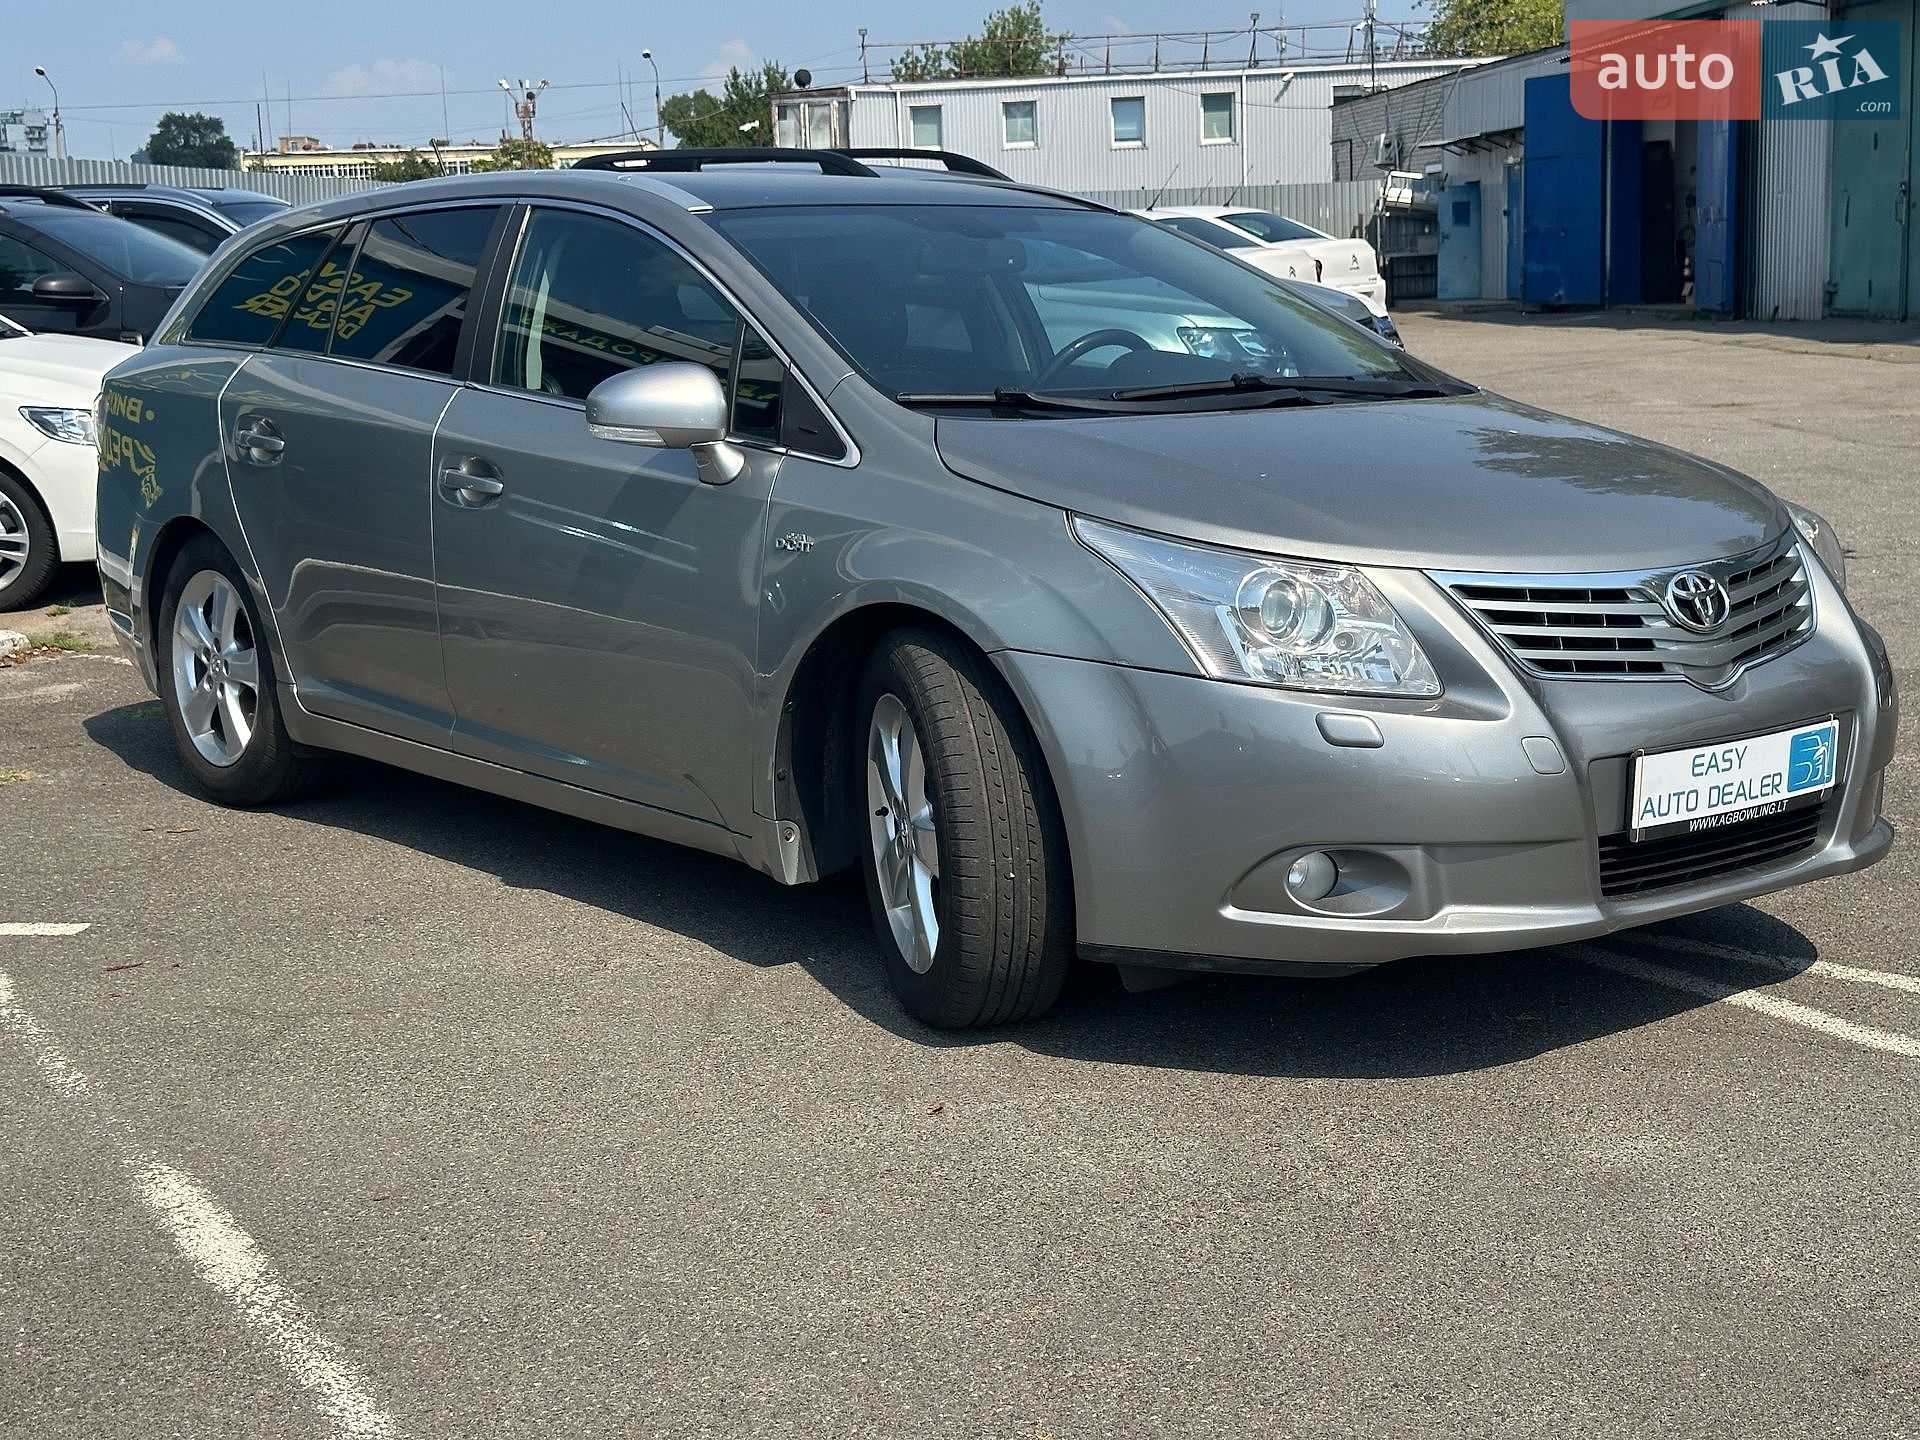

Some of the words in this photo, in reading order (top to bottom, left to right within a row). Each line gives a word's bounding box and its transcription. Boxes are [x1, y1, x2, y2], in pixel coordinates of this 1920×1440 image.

[1691, 745, 1748, 778] EASY
[1640, 788, 1699, 821] AUTO
[1707, 772, 1783, 809] DEALER
[1689, 800, 1789, 832] WWW.AGBOWLING.LT
